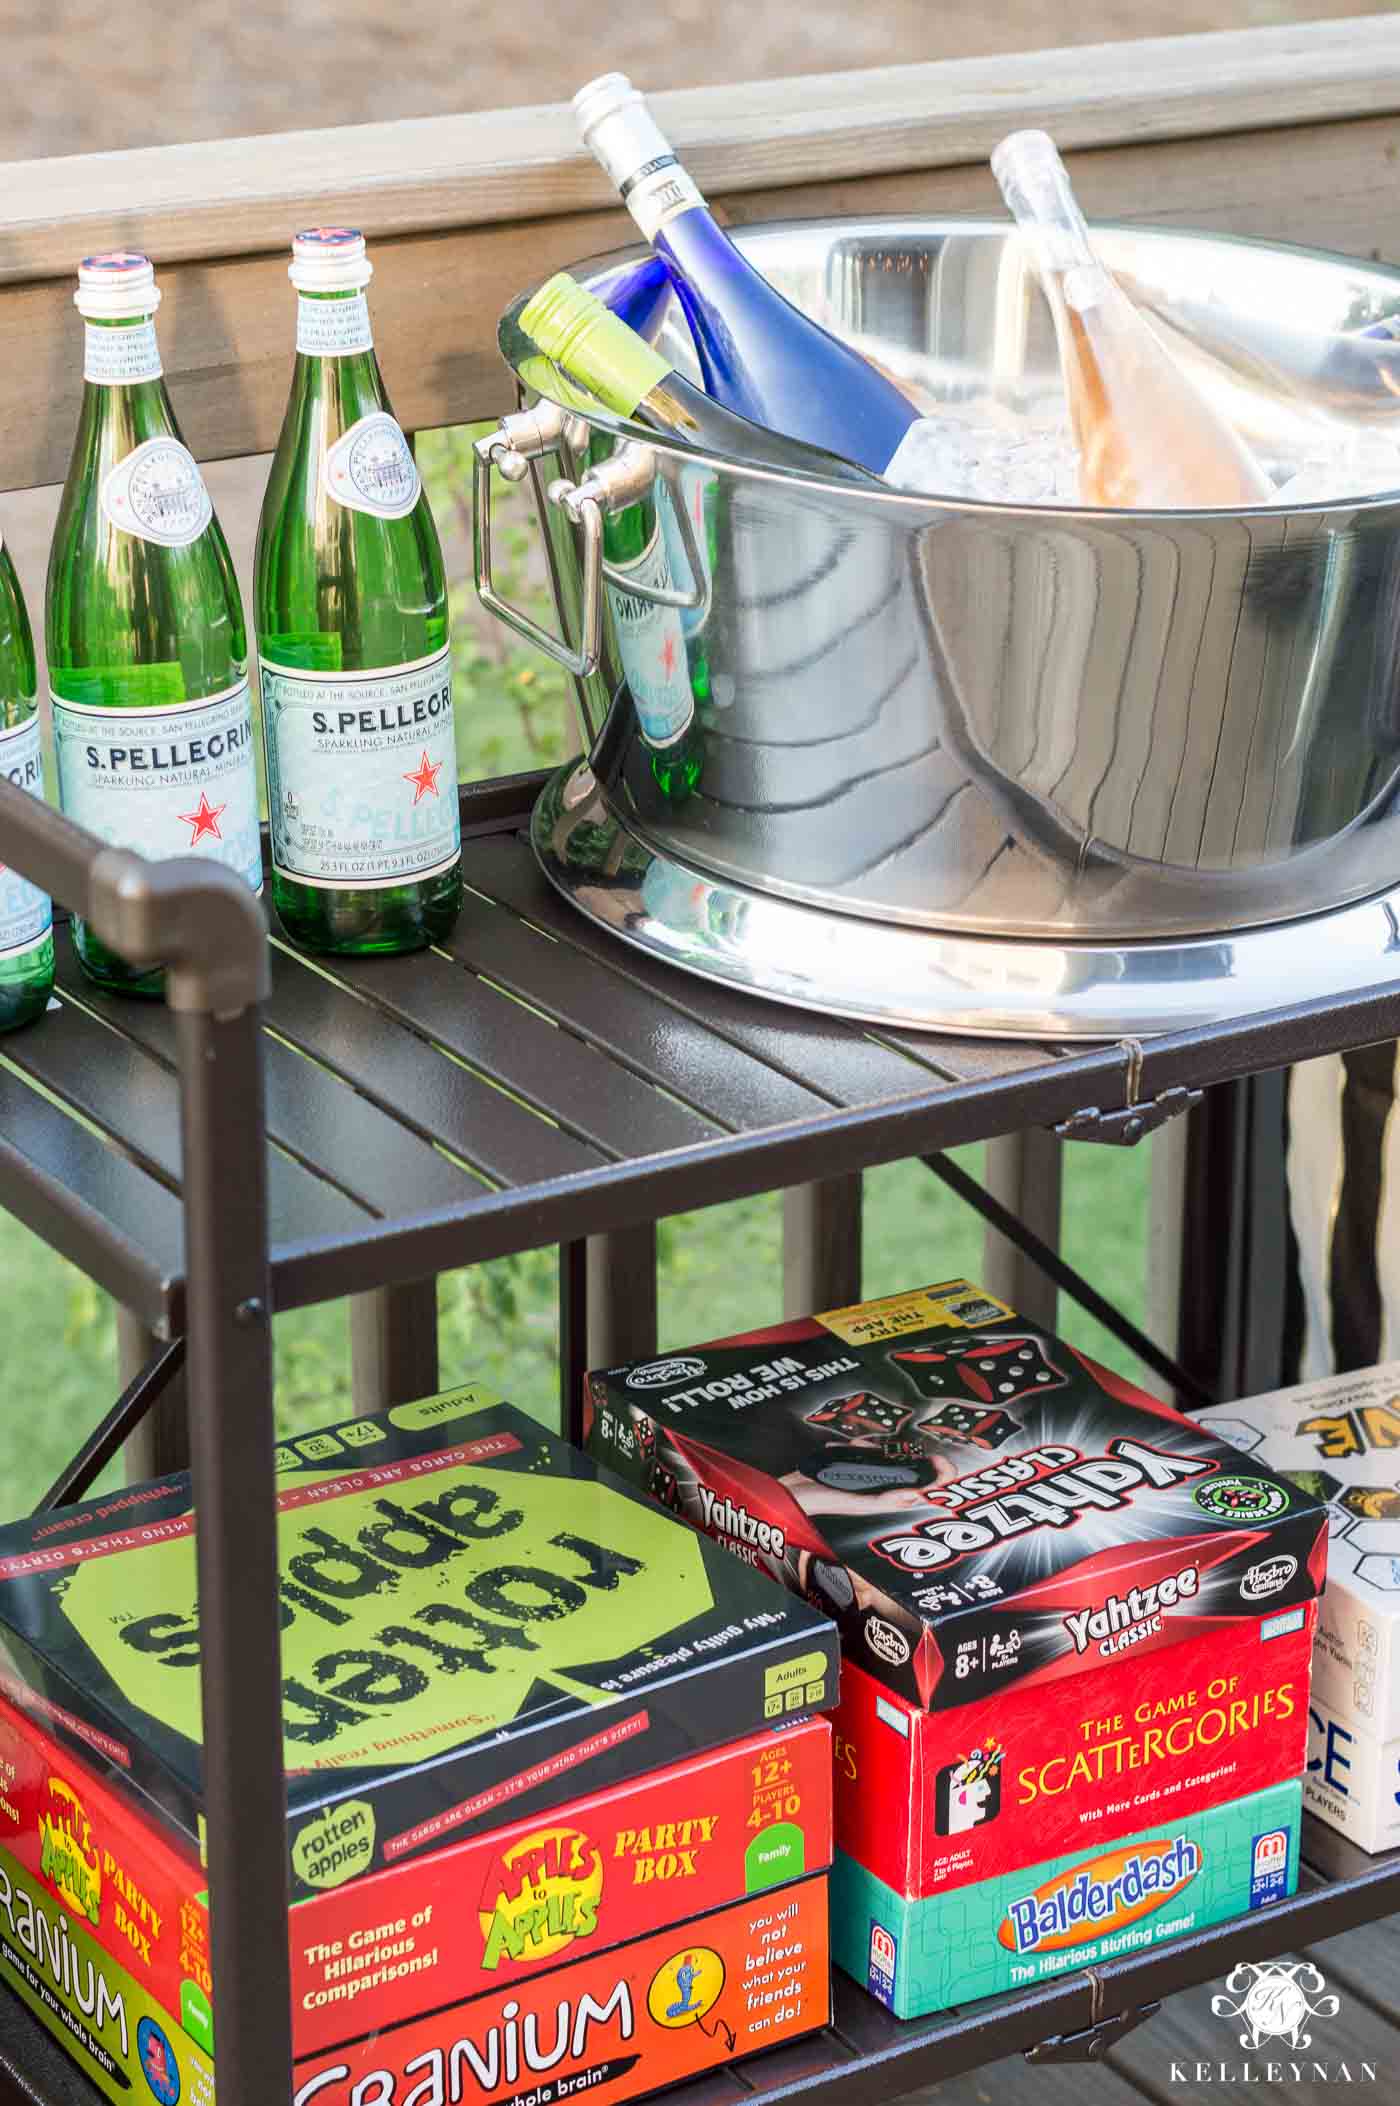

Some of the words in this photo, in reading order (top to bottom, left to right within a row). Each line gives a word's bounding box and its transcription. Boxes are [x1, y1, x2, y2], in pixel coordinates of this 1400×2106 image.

[317, 736, 383, 748] SPARKLING
[387, 727, 432, 745] NATURAL
[93, 773, 155, 786] SPARKLING
[159, 767, 212, 785] NATURAL
[749, 1356, 807, 1382] WE
[781, 1374, 808, 1391] IS
[804, 1357, 861, 1382] THIS
[418, 1393, 477, 1418] Adults
[660, 1373, 755, 1414] ROLL!
[727, 1384, 782, 1409] HOW
[344, 1424, 376, 1439] 17+
[409, 1450, 466, 1473] CARDS
[471, 1439, 507, 1455] THE
[306, 1477, 364, 1499] CLEAN
[367, 1467, 403, 1483] ARE
[926, 1446, 1078, 1508] CLASSIC
[880, 1440, 1212, 1570] Yahtzee
[142, 1520, 189, 1540] MIND
[698, 1485, 786, 1556] Yahtzee
[70, 1535, 136, 1557] THAT'S
[963, 1574, 997, 1590] 8+
[1247, 1562, 1294, 1587] Hasbro
[1063, 1566, 1199, 1655] Yahtzee
[691, 1624, 744, 1654] guilty
[870, 1617, 906, 1656] Hasbro
[956, 1639, 979, 1655] AGES
[1098, 1616, 1164, 1658] CLASSIC
[618, 1645, 695, 1685] pleasure
[775, 1666, 808, 1684] Adults
[954, 1654, 980, 1679] 8+
[599, 1678, 624, 1691] is
[1080, 1714, 1125, 1742] THE
[1133, 1691, 1198, 1724] GAME
[1206, 1676, 1240, 1700] OF
[759, 1746, 787, 1764] AGES
[1017, 1683, 1295, 1805] SCATTERGORIES
[390, 1836, 409, 1852] THE
[411, 1820, 442, 1842] CARDS
[444, 1807, 463, 1826] ARE
[464, 1794, 495, 1816] CLEAN
[503, 1779, 525, 1797] IT'S
[526, 1766, 551, 1784] YOUR
[551, 1752, 576, 1772] MIND
[577, 1736, 609, 1759] THAT'S
[610, 1718, 643, 1744] DIRTY!
[751, 1759, 793, 1789] 12+
[752, 1783, 796, 1808] PLAYERS
[1079, 1807, 1104, 1825] With
[1106, 1800, 1131, 1816] More
[1134, 1792, 1161, 1807] Cards
[1163, 1781, 1182, 1796] and
[1184, 1761, 1237, 1789] Categories!
[745, 1793, 801, 1829] 4-10
[301, 1810, 366, 1860] rotten
[613, 1815, 720, 1858] PARTY
[307, 1835, 370, 1879] apples
[632, 1850, 700, 1886] BOX
[757, 1844, 792, 1865] Family
[103, 1848, 162, 1940] PARTY
[532, 1887, 548, 1901] to
[1008, 1835, 1198, 1953] Balderdash
[748, 1915, 773, 1935] you
[776, 1902, 799, 1921] will
[113, 1901, 151, 1968] BOX
[303, 1941, 343, 1966] The
[348, 1918, 407, 1949] Game
[411, 1904, 433, 1928] of
[761, 1924, 788, 1945] not
[1010, 1964, 1035, 1983] The
[1039, 1945, 1098, 1975] Hilarious
[1100, 1930, 1153, 1955] Bluffing
[1155, 1912, 1196, 1936] Game!
[323, 1936, 416, 1982] Hilarious
[744, 1942, 803, 1972] believe
[302, 1947, 439, 2011] Comparisons!
[742, 1970, 775, 1991] what
[777, 1960, 807, 1982] your
[1, 1942, 26, 1974] game
[26, 1964, 40, 1986] for
[40, 1983, 60, 2012] your
[60, 2008, 87, 2044] whole
[746, 1978, 802, 2012] friends
[748, 2017, 772, 2033] can
[774, 1999, 801, 2024] do!
[506, 2086, 552, 2106] hole
